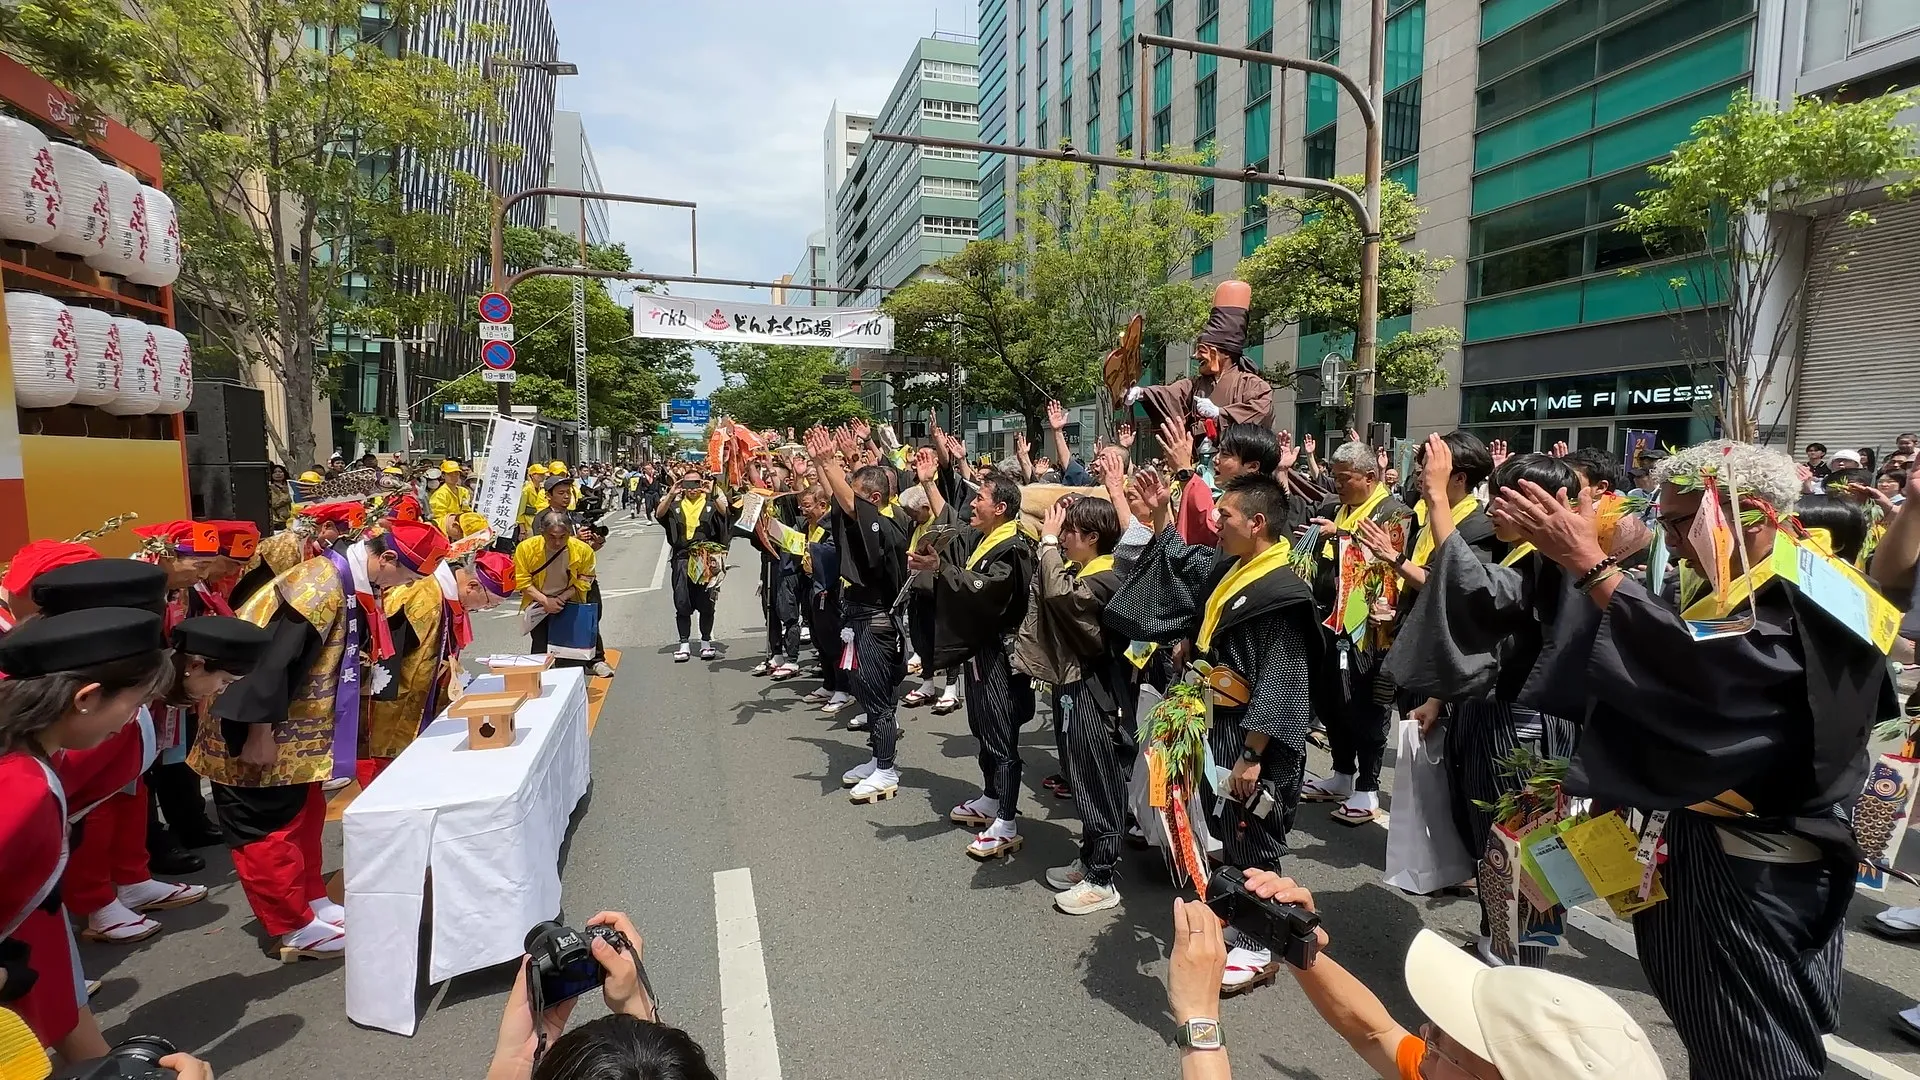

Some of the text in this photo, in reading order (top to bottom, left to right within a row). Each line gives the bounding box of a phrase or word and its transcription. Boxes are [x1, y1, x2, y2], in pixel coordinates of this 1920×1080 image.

[659, 309, 687, 328] rkb
[733, 313, 833, 338] どんたく広場
[856, 317, 882, 336] rkb
[1489, 384, 1714, 414] ANYTME FINESS
